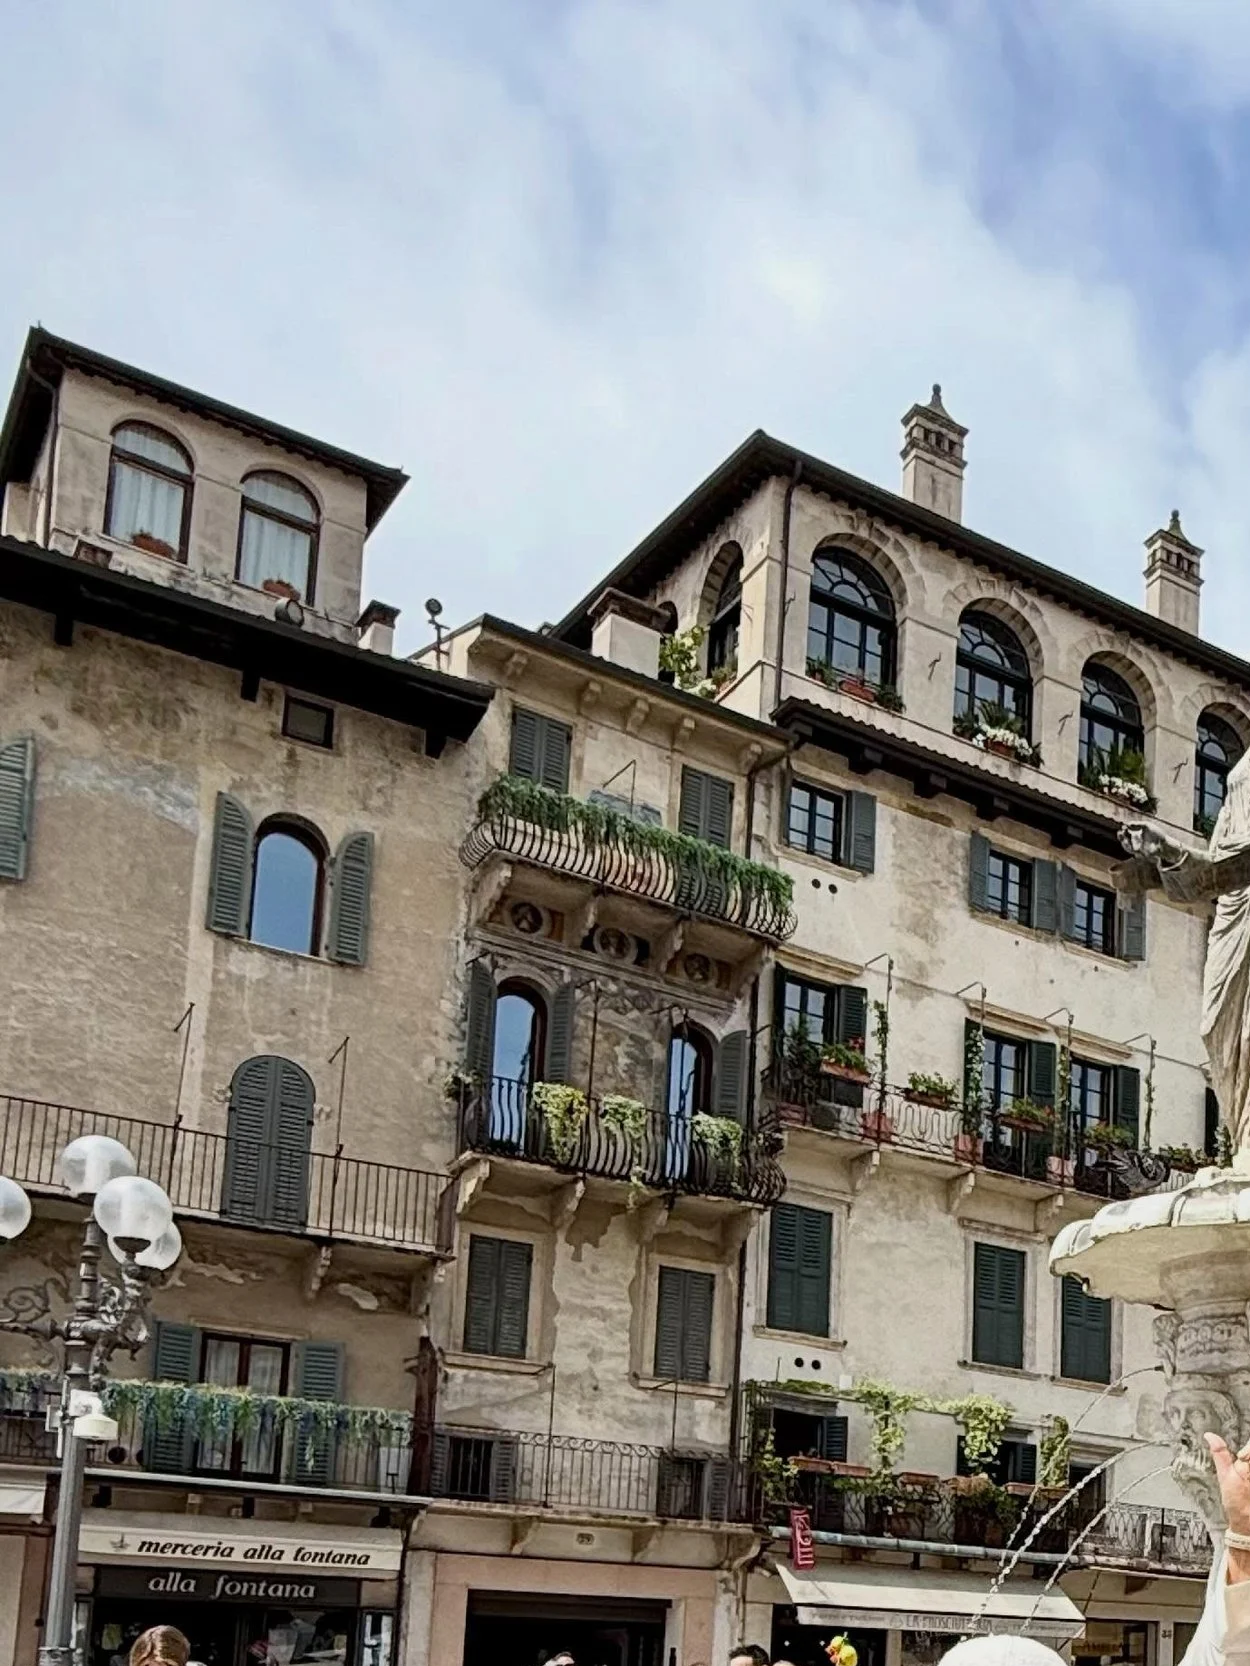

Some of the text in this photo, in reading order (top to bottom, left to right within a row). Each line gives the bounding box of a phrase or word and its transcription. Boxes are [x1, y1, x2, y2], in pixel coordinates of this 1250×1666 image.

[137, 1538, 370, 1566] merceria alla fontana
[148, 1572, 315, 1599] alla fontana
